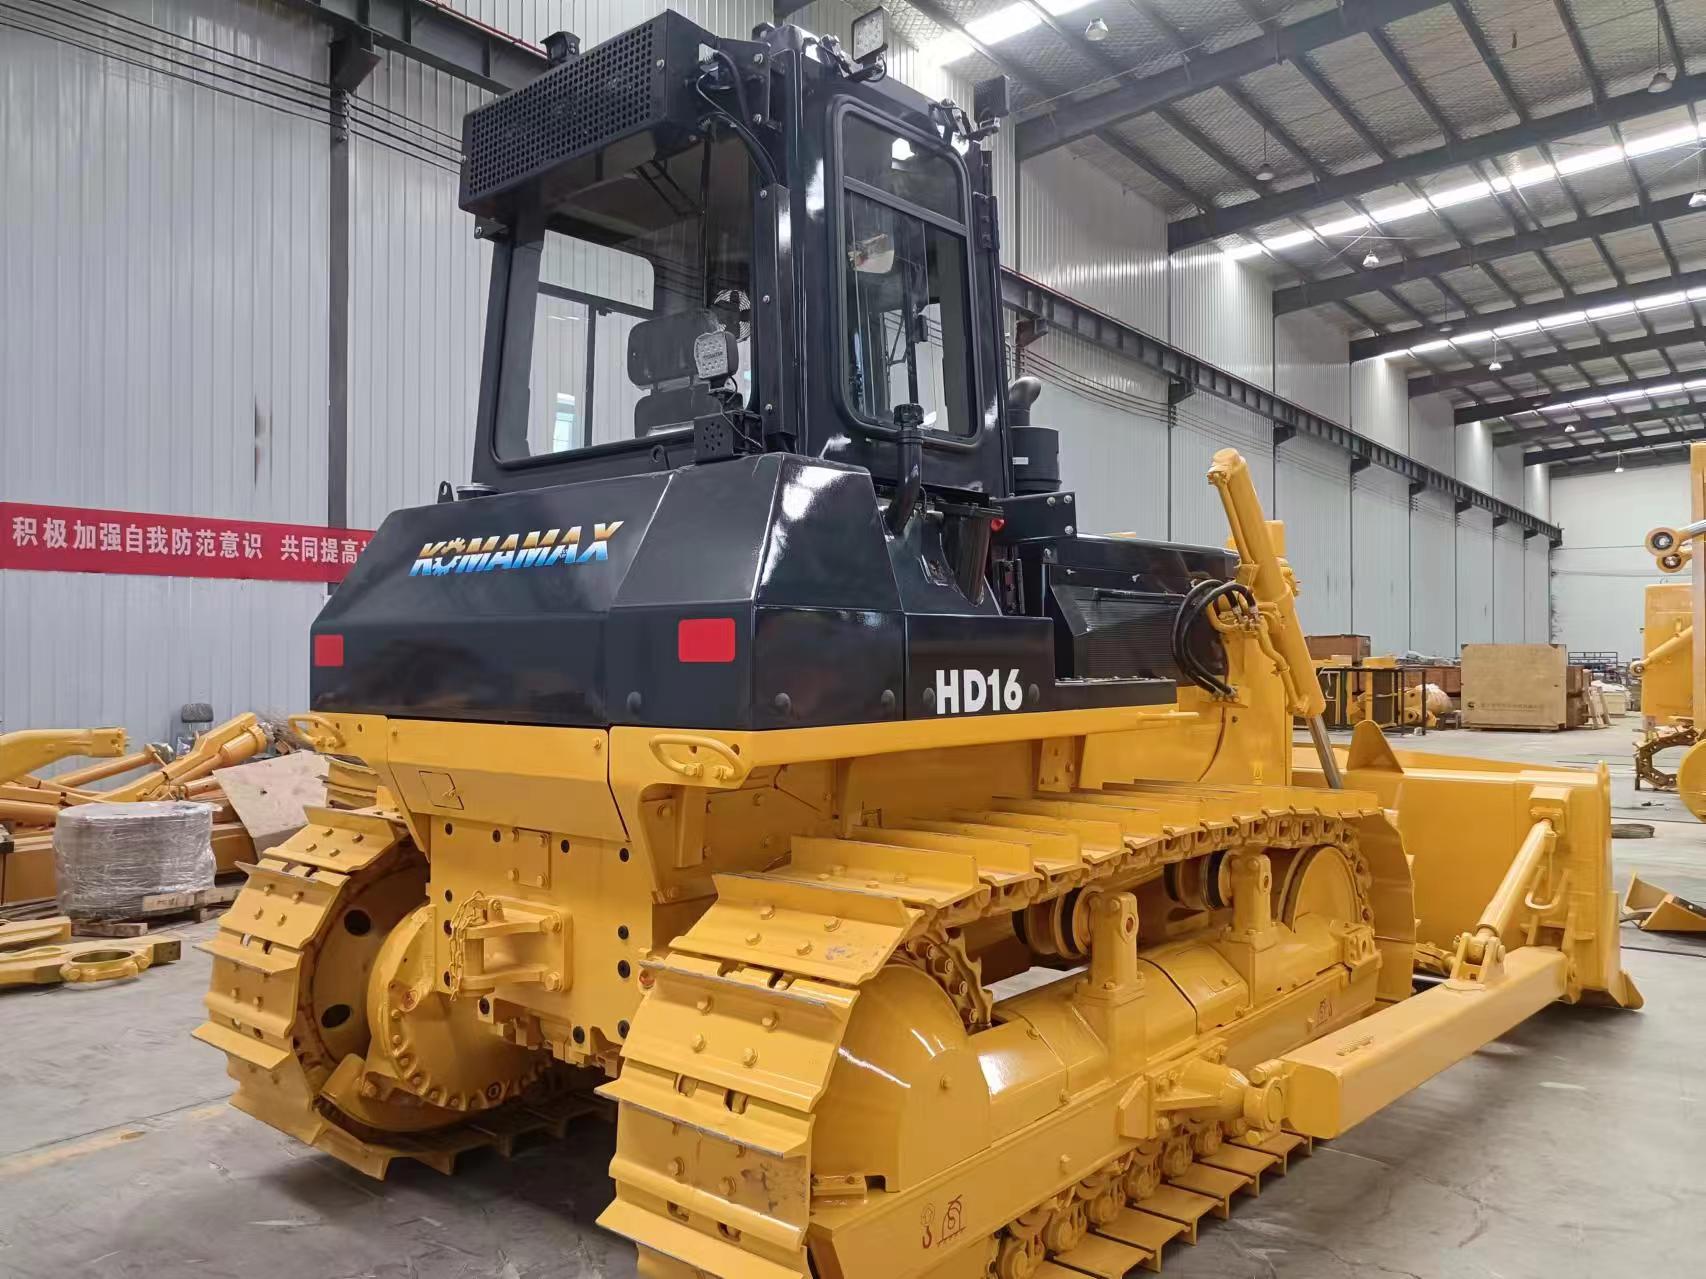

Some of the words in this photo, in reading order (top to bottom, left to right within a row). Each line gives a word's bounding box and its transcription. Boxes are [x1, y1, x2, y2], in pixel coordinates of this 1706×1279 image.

[12, 516, 263, 559] 积极加强自我防范意识
[281, 535, 367, 564] 共同提高
[408, 521, 624, 577] KOMAMAX
[936, 668, 1023, 714] HD16
